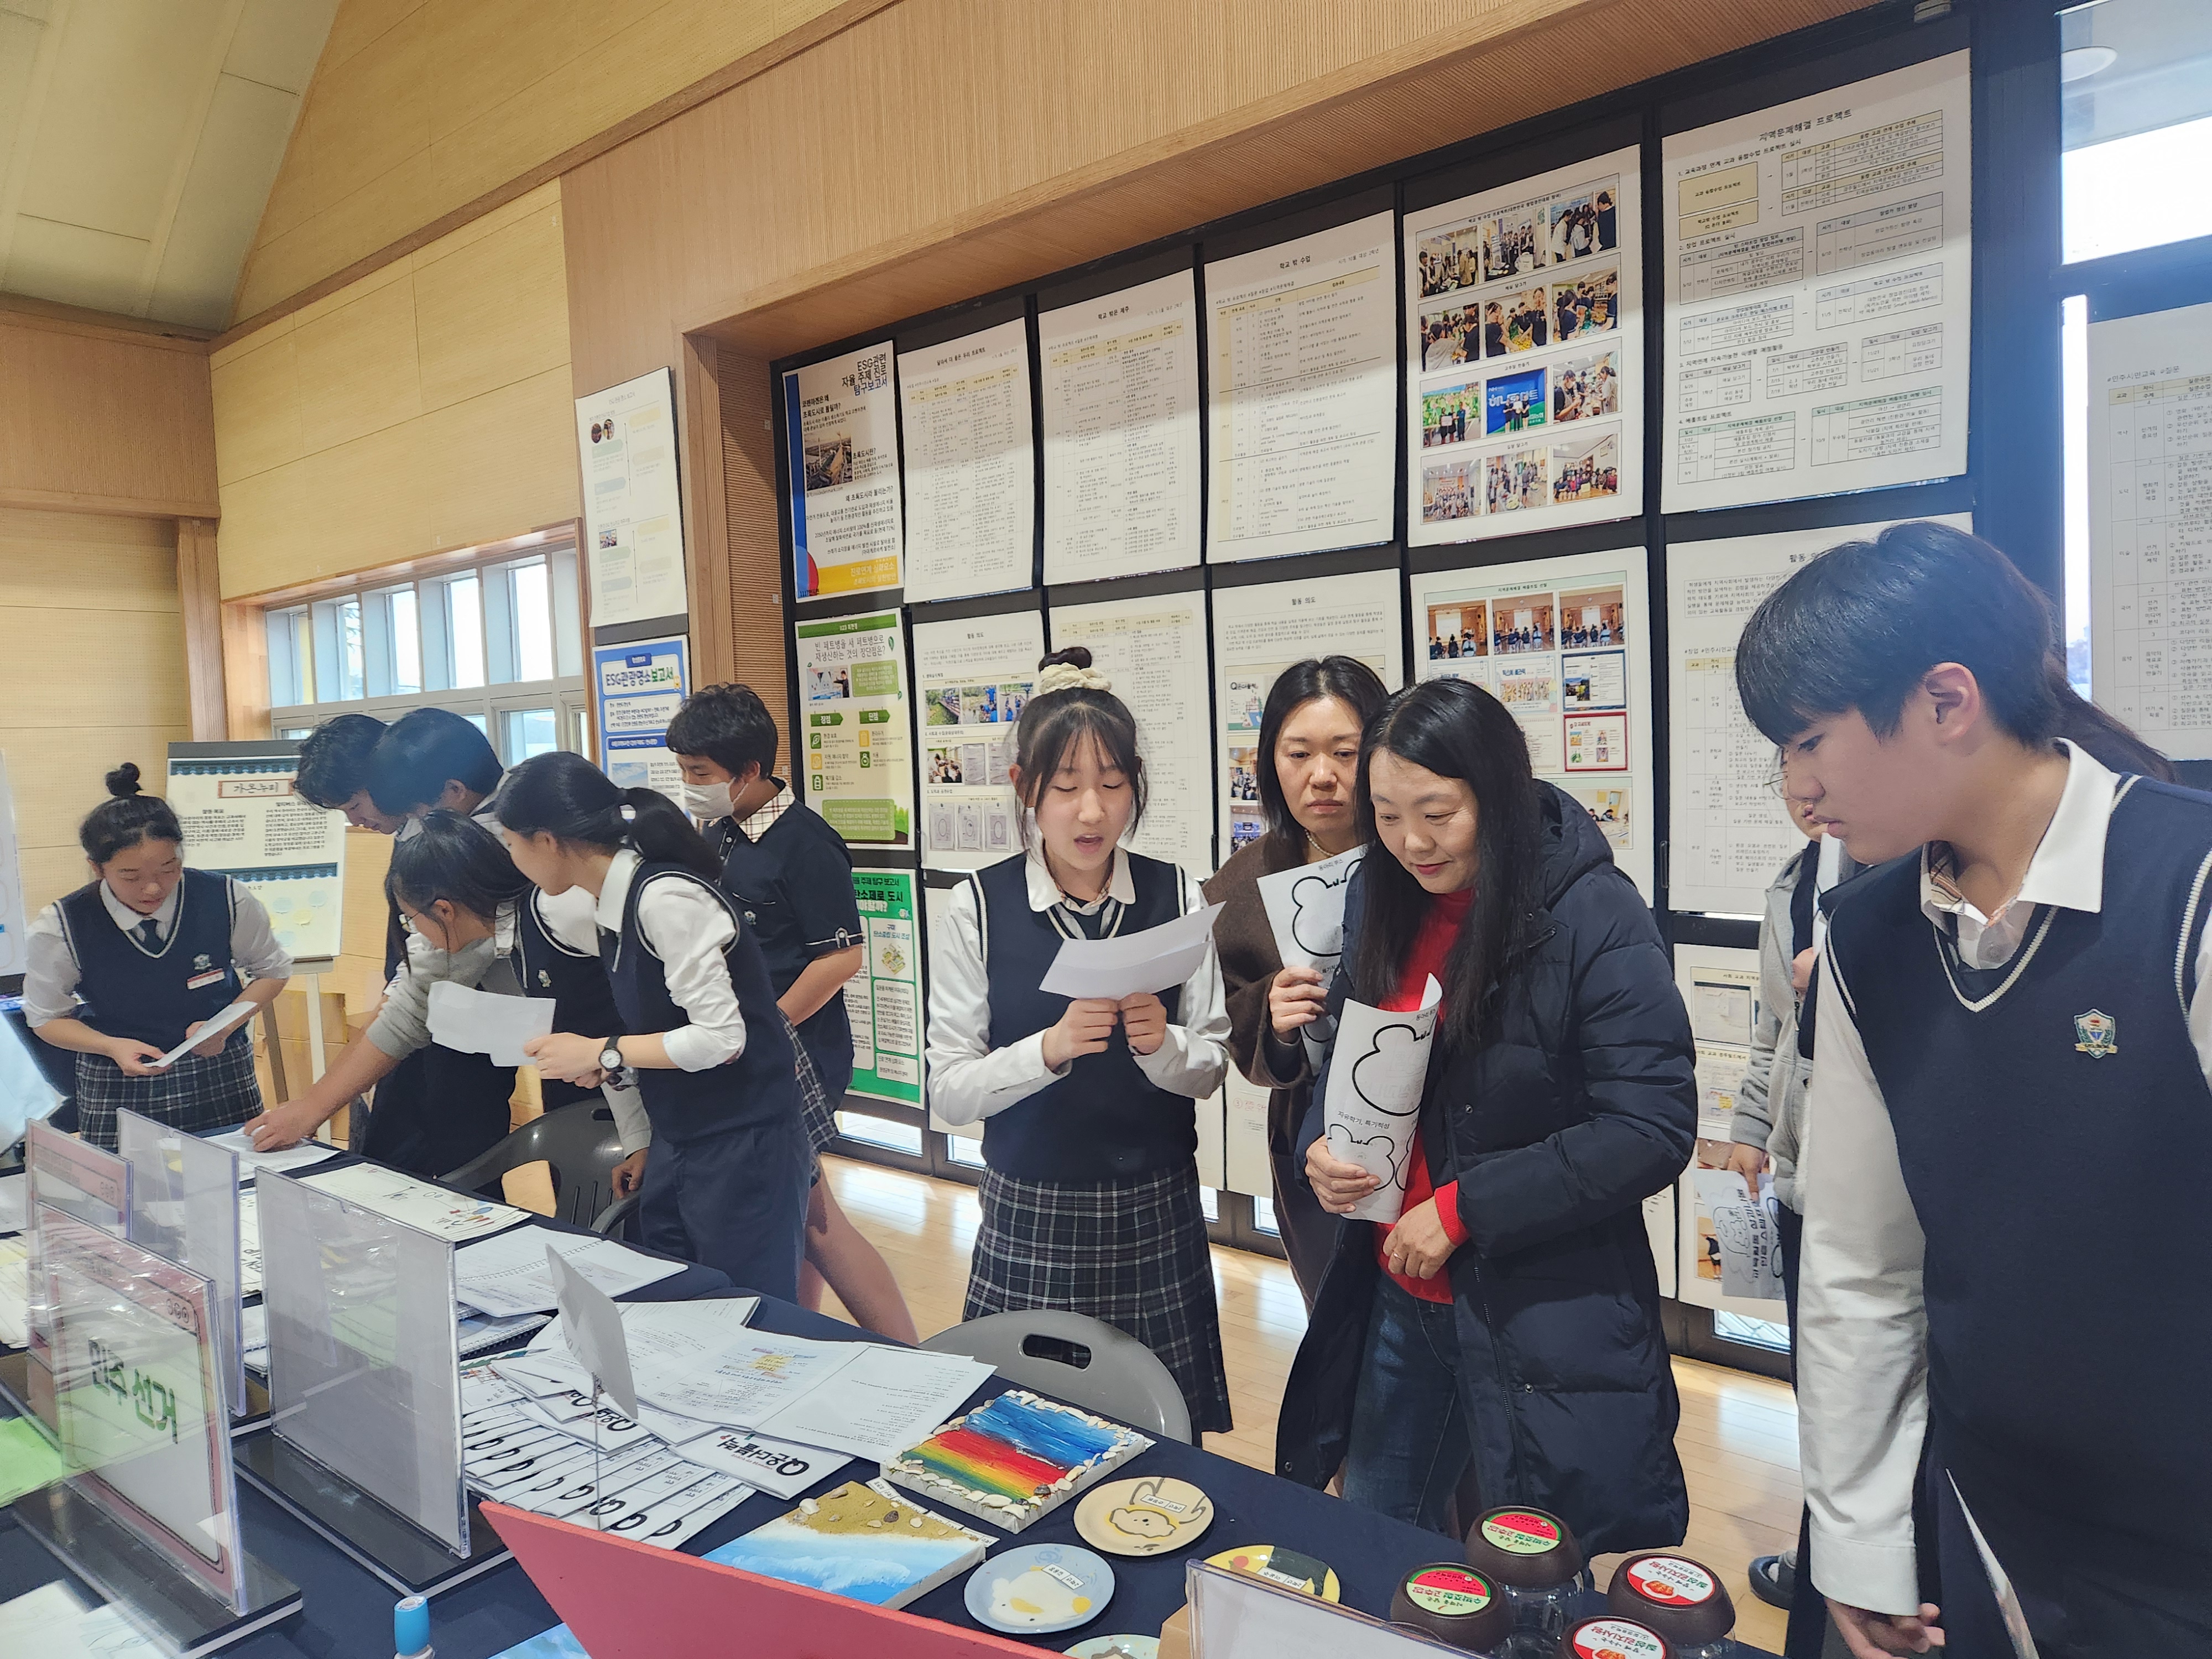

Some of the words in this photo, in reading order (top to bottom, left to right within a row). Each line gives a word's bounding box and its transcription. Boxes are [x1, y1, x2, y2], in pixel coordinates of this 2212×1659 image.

[1759, 119, 1812, 142] 지역문제해결
[1816, 109, 1852, 126] 프로젝트
[1700, 236, 1721, 245] 프로젝트
[1279, 261, 1290, 269] 학교
[1300, 255, 1311, 264] 수업
[857, 353, 886, 371] ESG관련
[842, 374, 855, 387] 자율
[858, 369, 872, 383] 주제
[874, 364, 887, 378] 진로
[2107, 370, 2156, 382] #민주시민교육
[2160, 366, 2179, 374] #질문
[854, 377, 887, 396] 탐구보고서
[1790, 554, 1806, 562] 활동
[815, 642, 820, 652] 빈
[823, 639, 846, 650] 페트병을
[849, 638, 854, 648] 새
[857, 635, 884, 646] 페트병으로
[815, 651, 844, 662] 재생산하는
[847, 649, 857, 659] 것의
[860, 645, 885, 658] 장단점은?
[821, 715, 831, 724] 장점
[868, 712, 878, 721] 단점
[233, 782, 279, 794] 가온누리
[888, 891, 903, 902] 도시
[1338, 1110, 1363, 1126] 자유학기,
[1365, 1119, 1390, 1130] 특기적성
[1486, 1525, 1515, 1537] 고추장
[1412, 1586, 1442, 1598] 고추장
[1443, 1592, 1482, 1604] 수박조청
